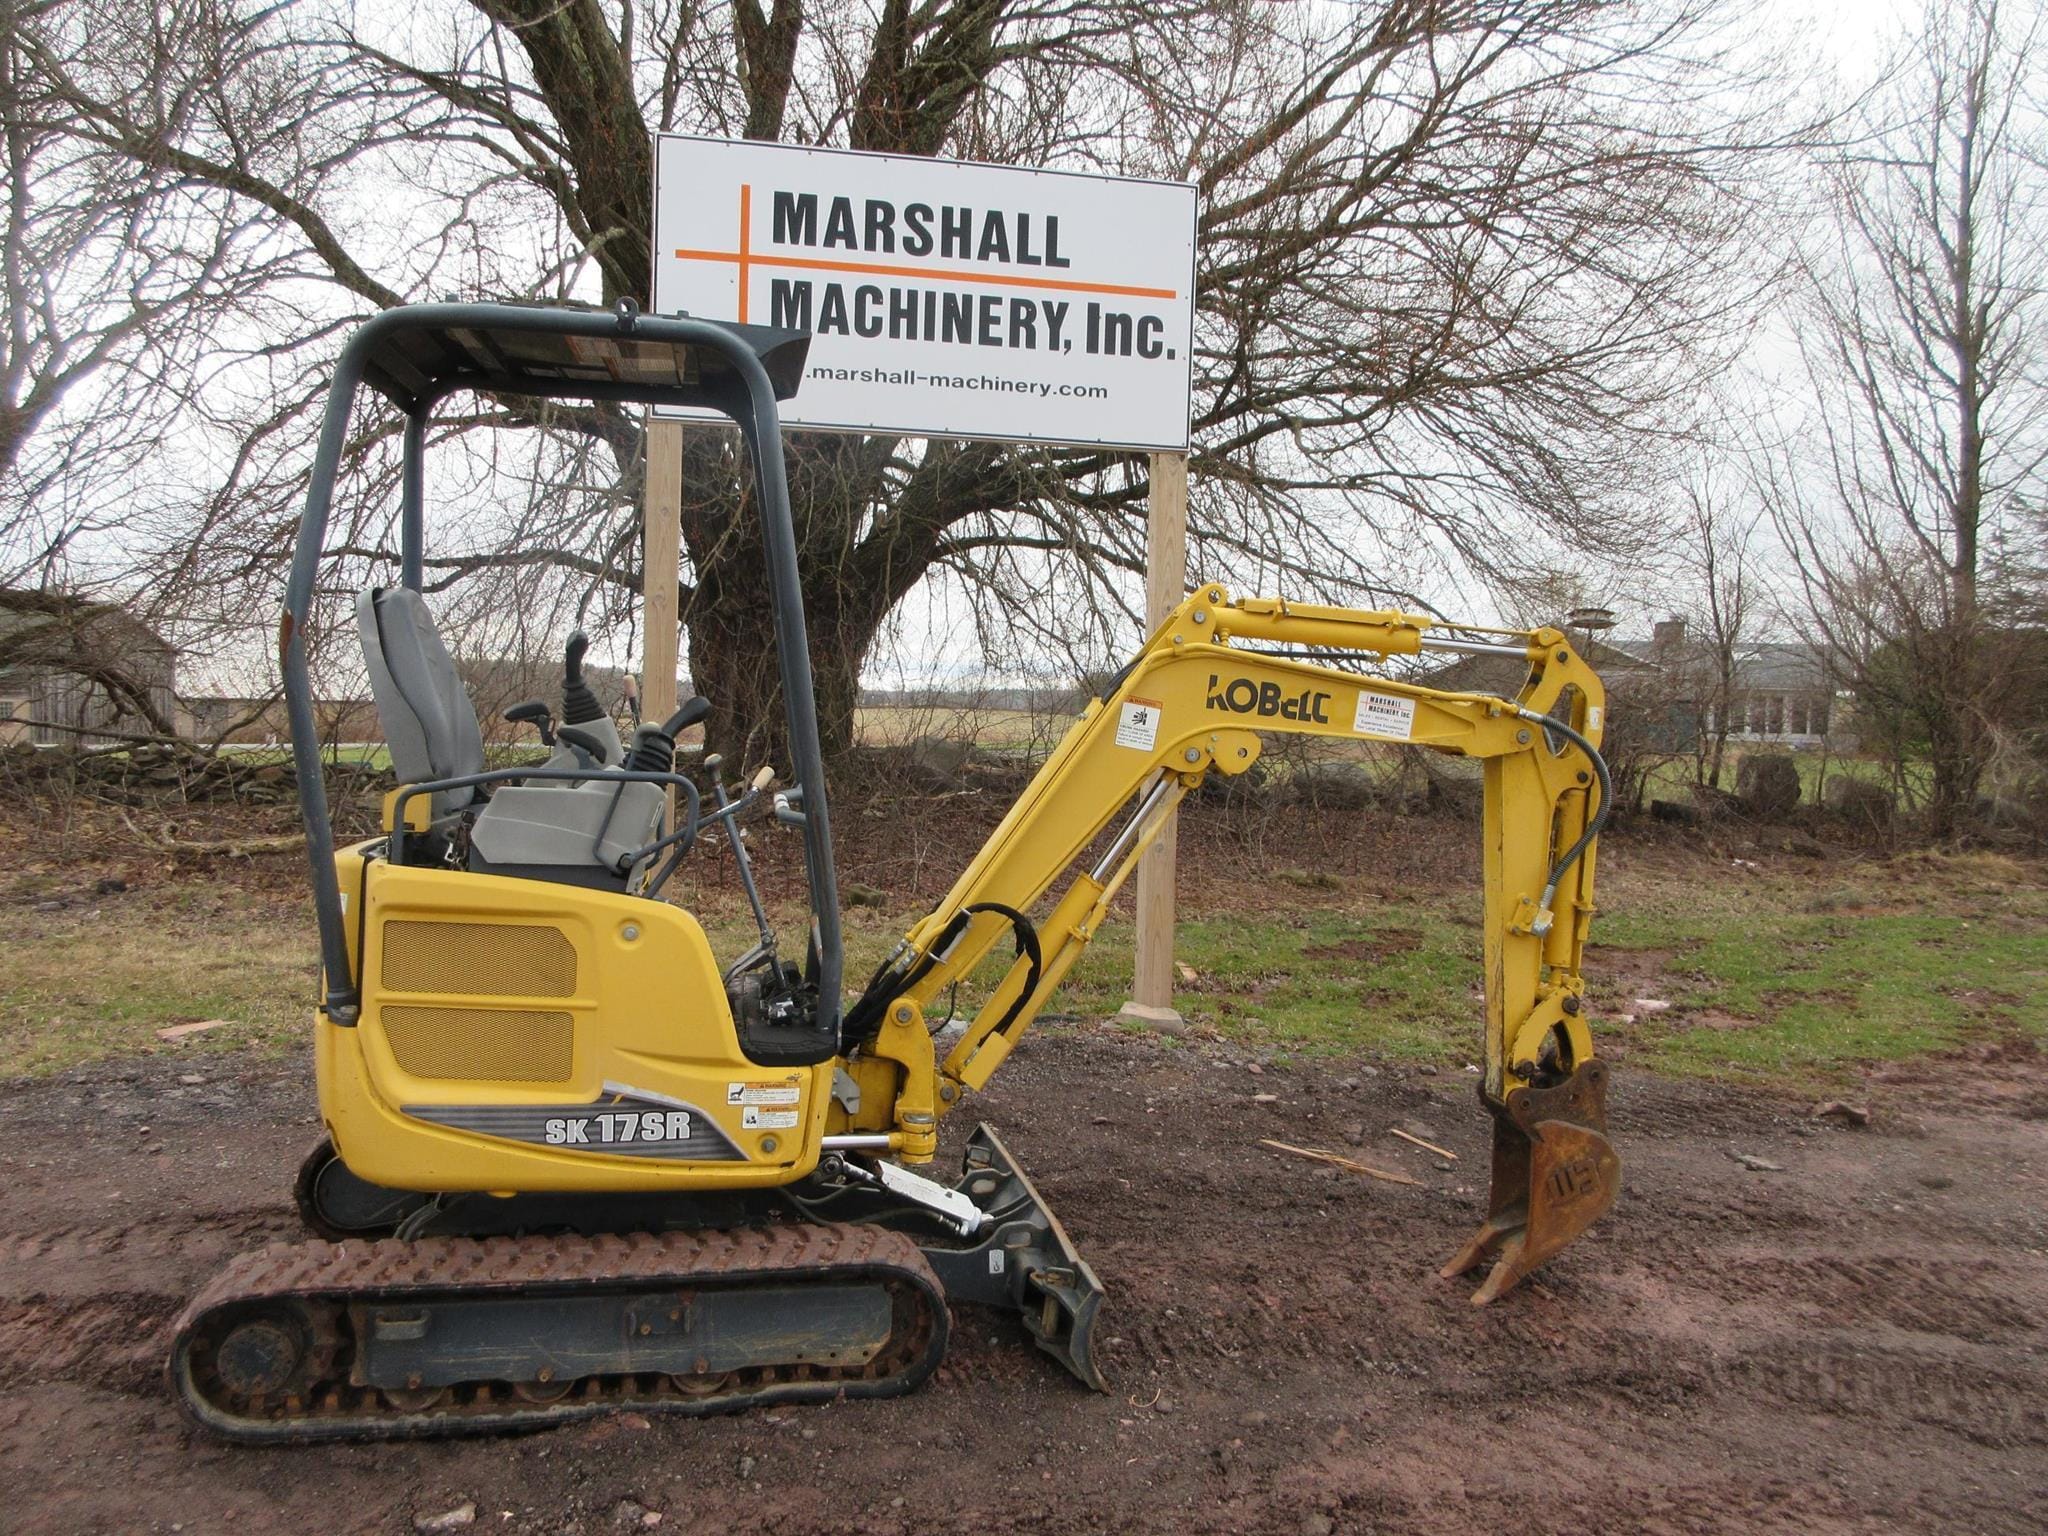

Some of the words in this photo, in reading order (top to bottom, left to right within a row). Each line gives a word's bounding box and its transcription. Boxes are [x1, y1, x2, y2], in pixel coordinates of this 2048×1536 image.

[772, 190, 1071, 269] MARSHALL
[770, 278, 1072, 356] MACHINERY,
[1086, 301, 1176, 361] Inc.
